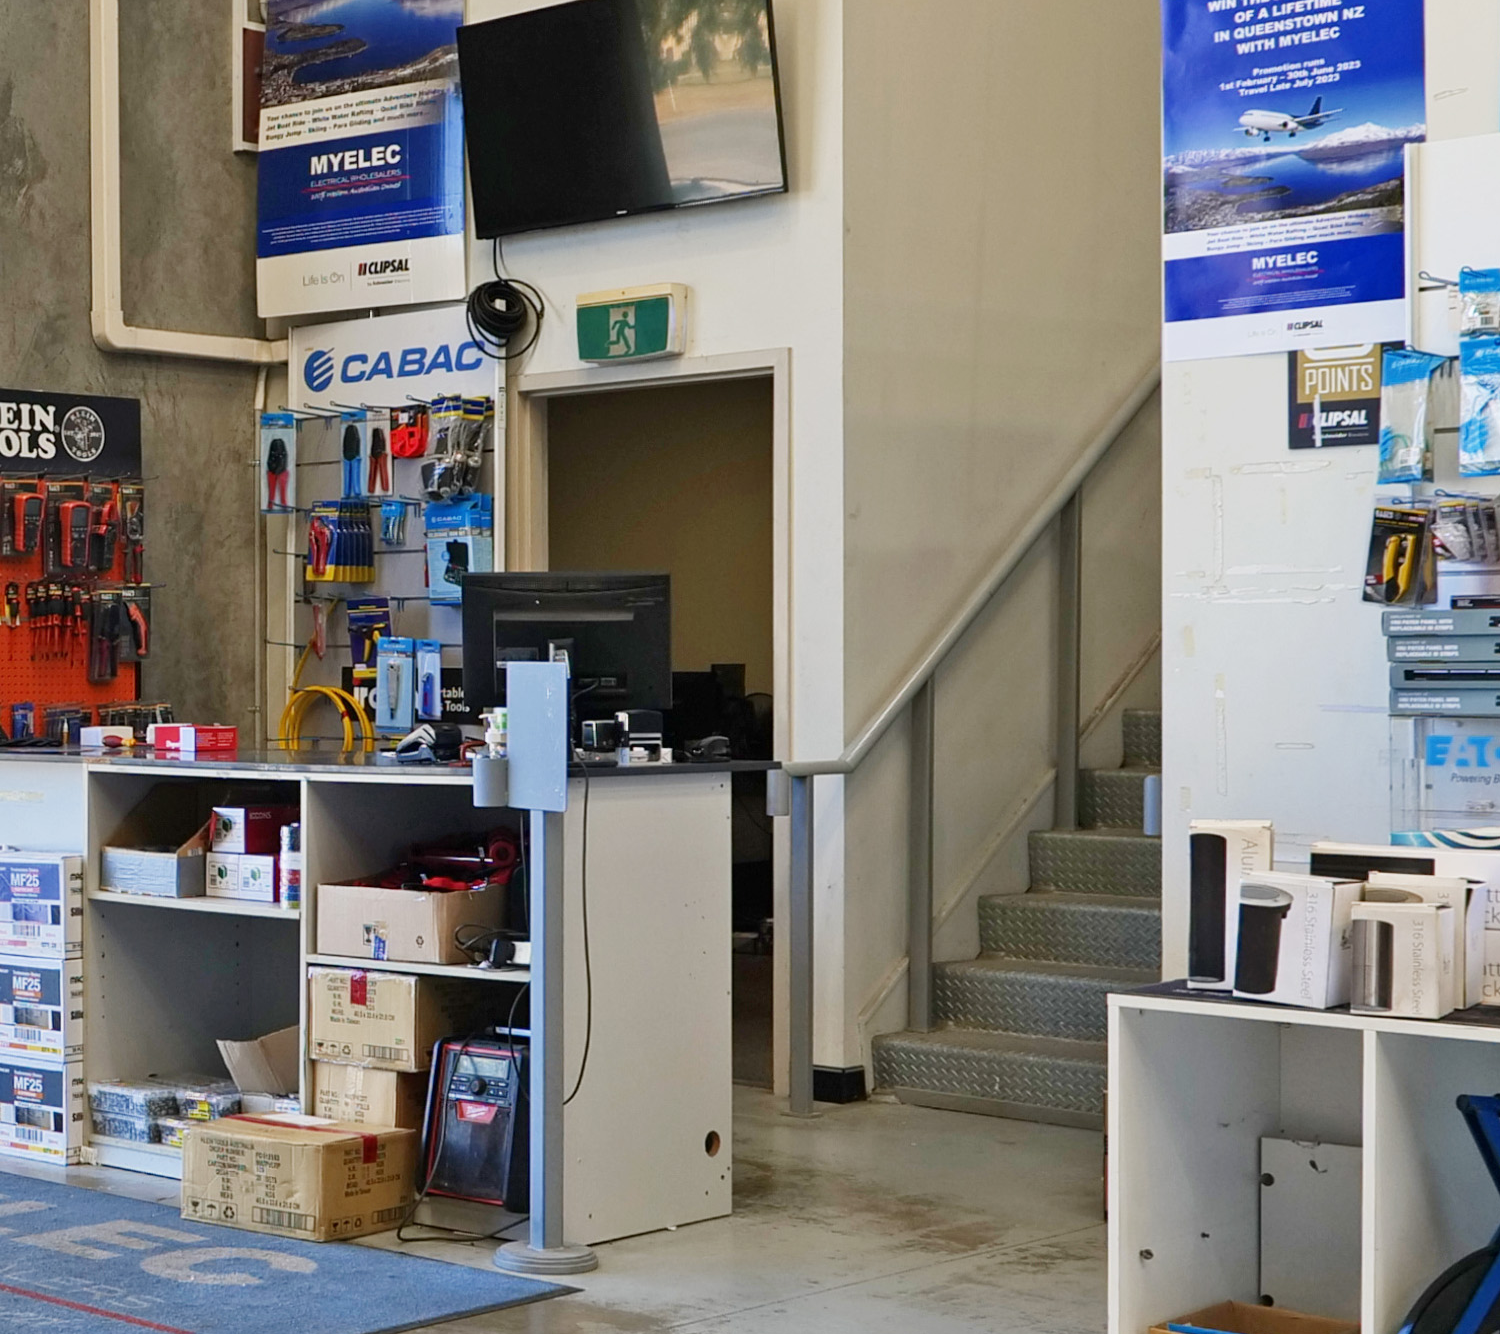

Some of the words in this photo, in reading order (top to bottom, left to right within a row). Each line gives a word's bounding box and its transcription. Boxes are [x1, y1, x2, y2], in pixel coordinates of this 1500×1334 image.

[1214, 30, 1230, 43] IN
[1233, 11, 1338, 39] QUEENSTOWN
[1342, 6, 1365, 20] NZ
[1234, 10, 1254, 23] OF
[1258, 7, 1269, 19] A
[1236, 38, 1275, 55] WITH
[1278, 26, 1340, 48] MYELEC
[1219, 83, 1234, 91] 1st
[1236, 75, 1278, 89] February
[1310, 66, 1334, 76] June
[1337, 60, 1361, 72] 2023
[1253, 62, 1301, 76] Promotion
[1303, 58, 1325, 68] runs
[1239, 86, 1268, 96] Travel
[1269, 83, 1291, 92] Late
[1294, 78, 1313, 88] July
[1315, 73, 1340, 84] 2023
[310, 144, 401, 175] MYELEC
[369, 259, 410, 275] CLIPSAL
[1252, 251, 1318, 271] MYELEC
[340, 340, 485, 384] CABAC
[1305, 364, 1373, 395] POINTS
[1451, 773, 1490, 785] Powering
[10, 873, 39, 887] MF25
[1412, 920, 1424, 939] 316
[1302, 917, 1317, 967] Stainless
[1412, 942, 1425, 986] Stainless
[13, 976, 41, 992] MF25
[1300, 969, 1314, 1000] Steel
[1411, 989, 1424, 1015] Steel
[14, 1075, 43, 1092] MF25
